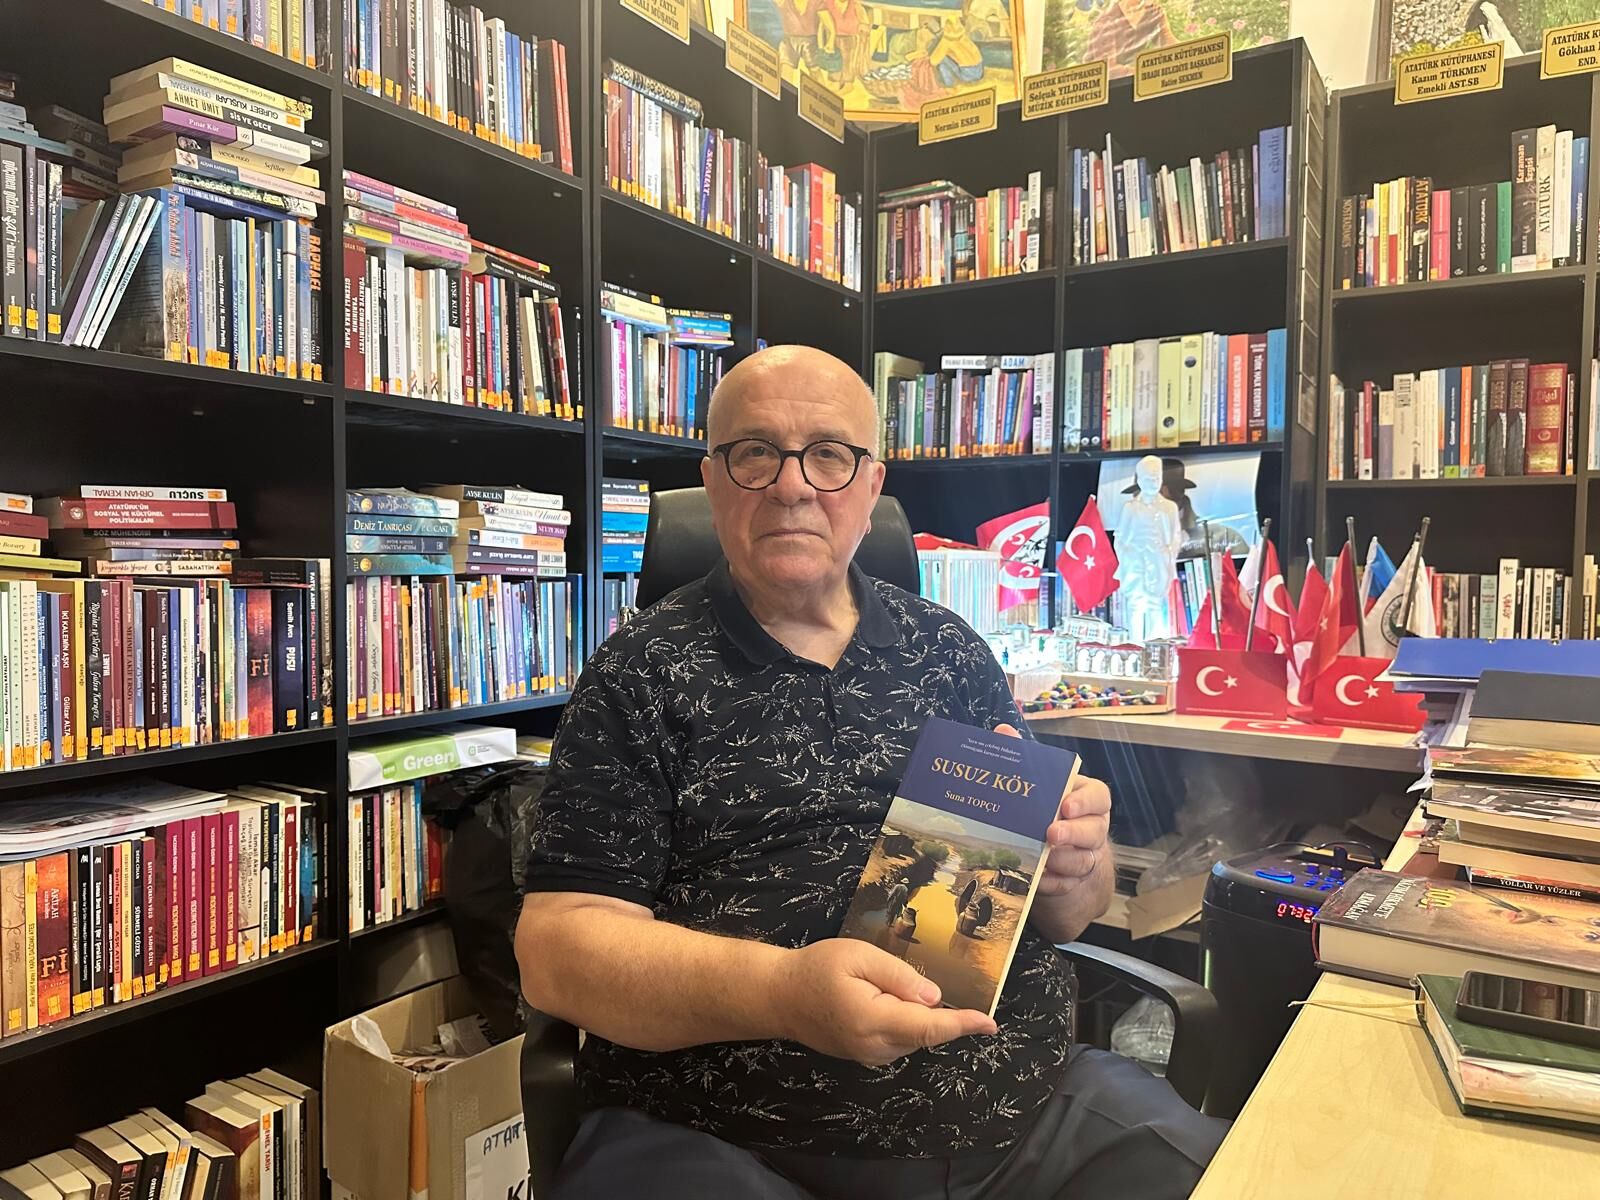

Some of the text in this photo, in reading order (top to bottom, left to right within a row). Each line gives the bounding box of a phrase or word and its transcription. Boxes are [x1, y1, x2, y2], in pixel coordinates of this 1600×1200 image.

[1551, 31, 1590, 46] ATATÜRK
[1140, 41, 1224, 68] ATATÜRK KÜTÜPHANESİ
[1558, 44, 1596, 57] Gökhan
[1404, 50, 1496, 74] ATATÜRK KÜTÜPHANESİ
[1577, 57, 1598, 67] END.
[1027, 74, 1058, 91] ATATÜRK
[1411, 64, 1487, 85] Kazım TÜRKMEN
[1028, 78, 1101, 103] Selçuk YILDIRIM
[1417, 83, 1447, 95] Emekli
[173, 91, 220, 116] AHMET ÜMİT
[249, 104, 279, 120] GURBET
[923, 106, 950, 120] ATATÜRK
[188, 118, 205, 129] Pınar
[229, 111, 272, 131] SİS VE GECE
[934, 115, 981, 133] Nermin ESER
[264, 161, 286, 173] Sefiller
[1516, 144, 1526, 184] Karaman
[1525, 156, 1535, 182] Ezgisi
[2, 160, 18, 189] göçmen
[3, 190, 19, 215] gözler
[309, 234, 321, 291] RAPHAEL
[450, 279, 458, 324] AYŞE KULİN
[1253, 354, 1263, 370] TÜRK
[92, 488, 204, 499] ORHAN KEMAL SUÇLU
[465, 490, 503, 500] AYŞE KULİN
[131, 510, 164, 518] KÜLTÜREL
[353, 519, 449, 533] DENİZ TANRIÇASI CAST
[2, 541, 26, 550] Bovary
[61, 609, 70, 619] İKİ
[62, 619, 70, 649] KALEMİN
[126, 626, 134, 658] MEHMET
[286, 602, 296, 672] Semih Avcı PUSU
[60, 650, 70, 668] AŞKI
[161, 670, 168, 680] VE
[62, 695, 71, 719] Gülizar
[402, 750, 456, 772] Green
[931, 757, 1037, 798] SUSUZ KÖY
[944, 789, 1001, 813] Suna TOPÇU
[1499, 878, 1581, 898] YOLLAR VE YÜZLER
[1343, 891, 1377, 921] ARMAĞAN
[40, 947, 69, 979] Fİ
